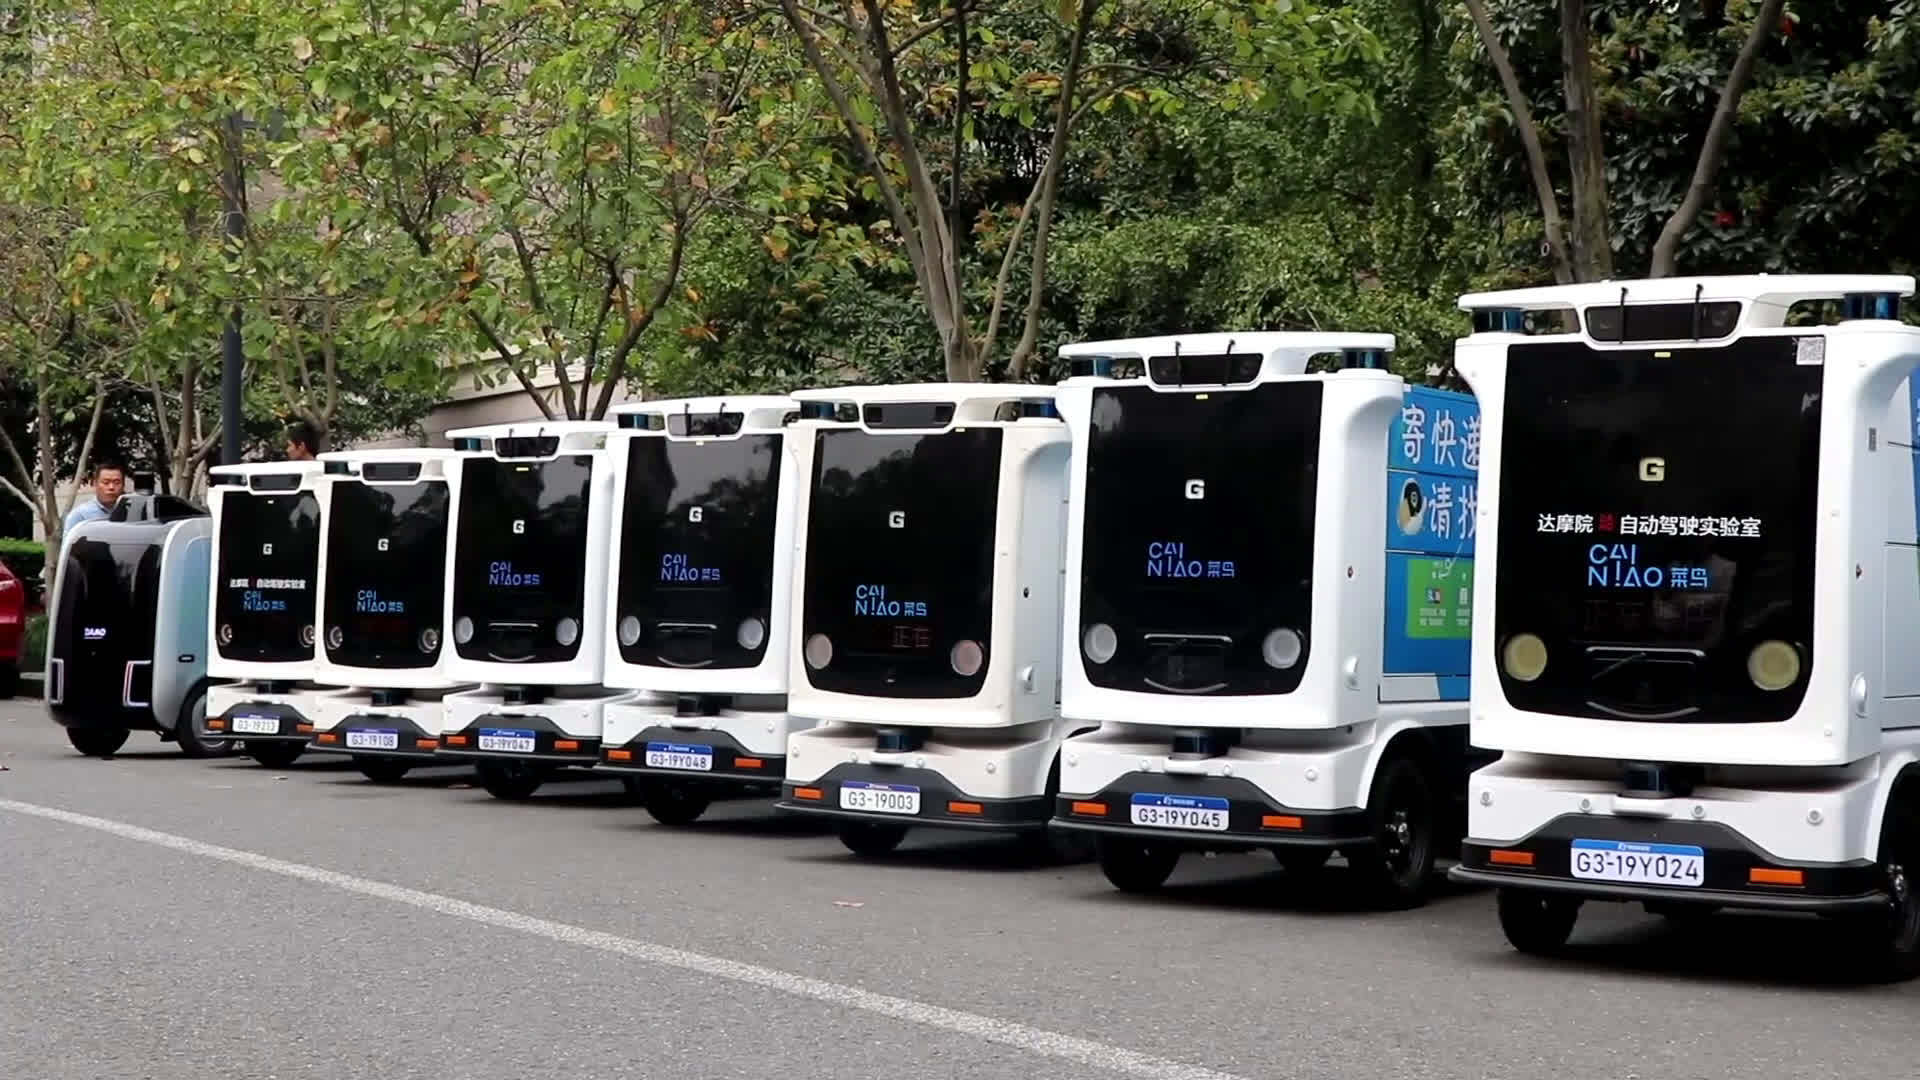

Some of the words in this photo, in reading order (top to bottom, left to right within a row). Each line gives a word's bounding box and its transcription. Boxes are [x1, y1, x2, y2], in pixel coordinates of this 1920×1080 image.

[1402, 404, 1480, 470] 寄快递
[1639, 457, 1665, 482] G
[1185, 479, 1205, 500] G
[688, 506, 703, 522] G
[888, 511, 905, 528] G
[1537, 513, 1594, 534] 达摩院
[1620, 514, 1762, 537] 自动驾驶实验室
[1148, 542, 1184, 559] CAI
[1589, 543, 1636, 565] CAI
[1671, 567, 1708, 588] 菜鸟
[856, 584, 885, 600] CAI
[651, 753, 706, 768] G3-19Y048
[848, 791, 913, 810] G3-19003
[1138, 808, 1220, 828] G3-19Y045
[1577, 852, 1699, 881] G3-19Y024
